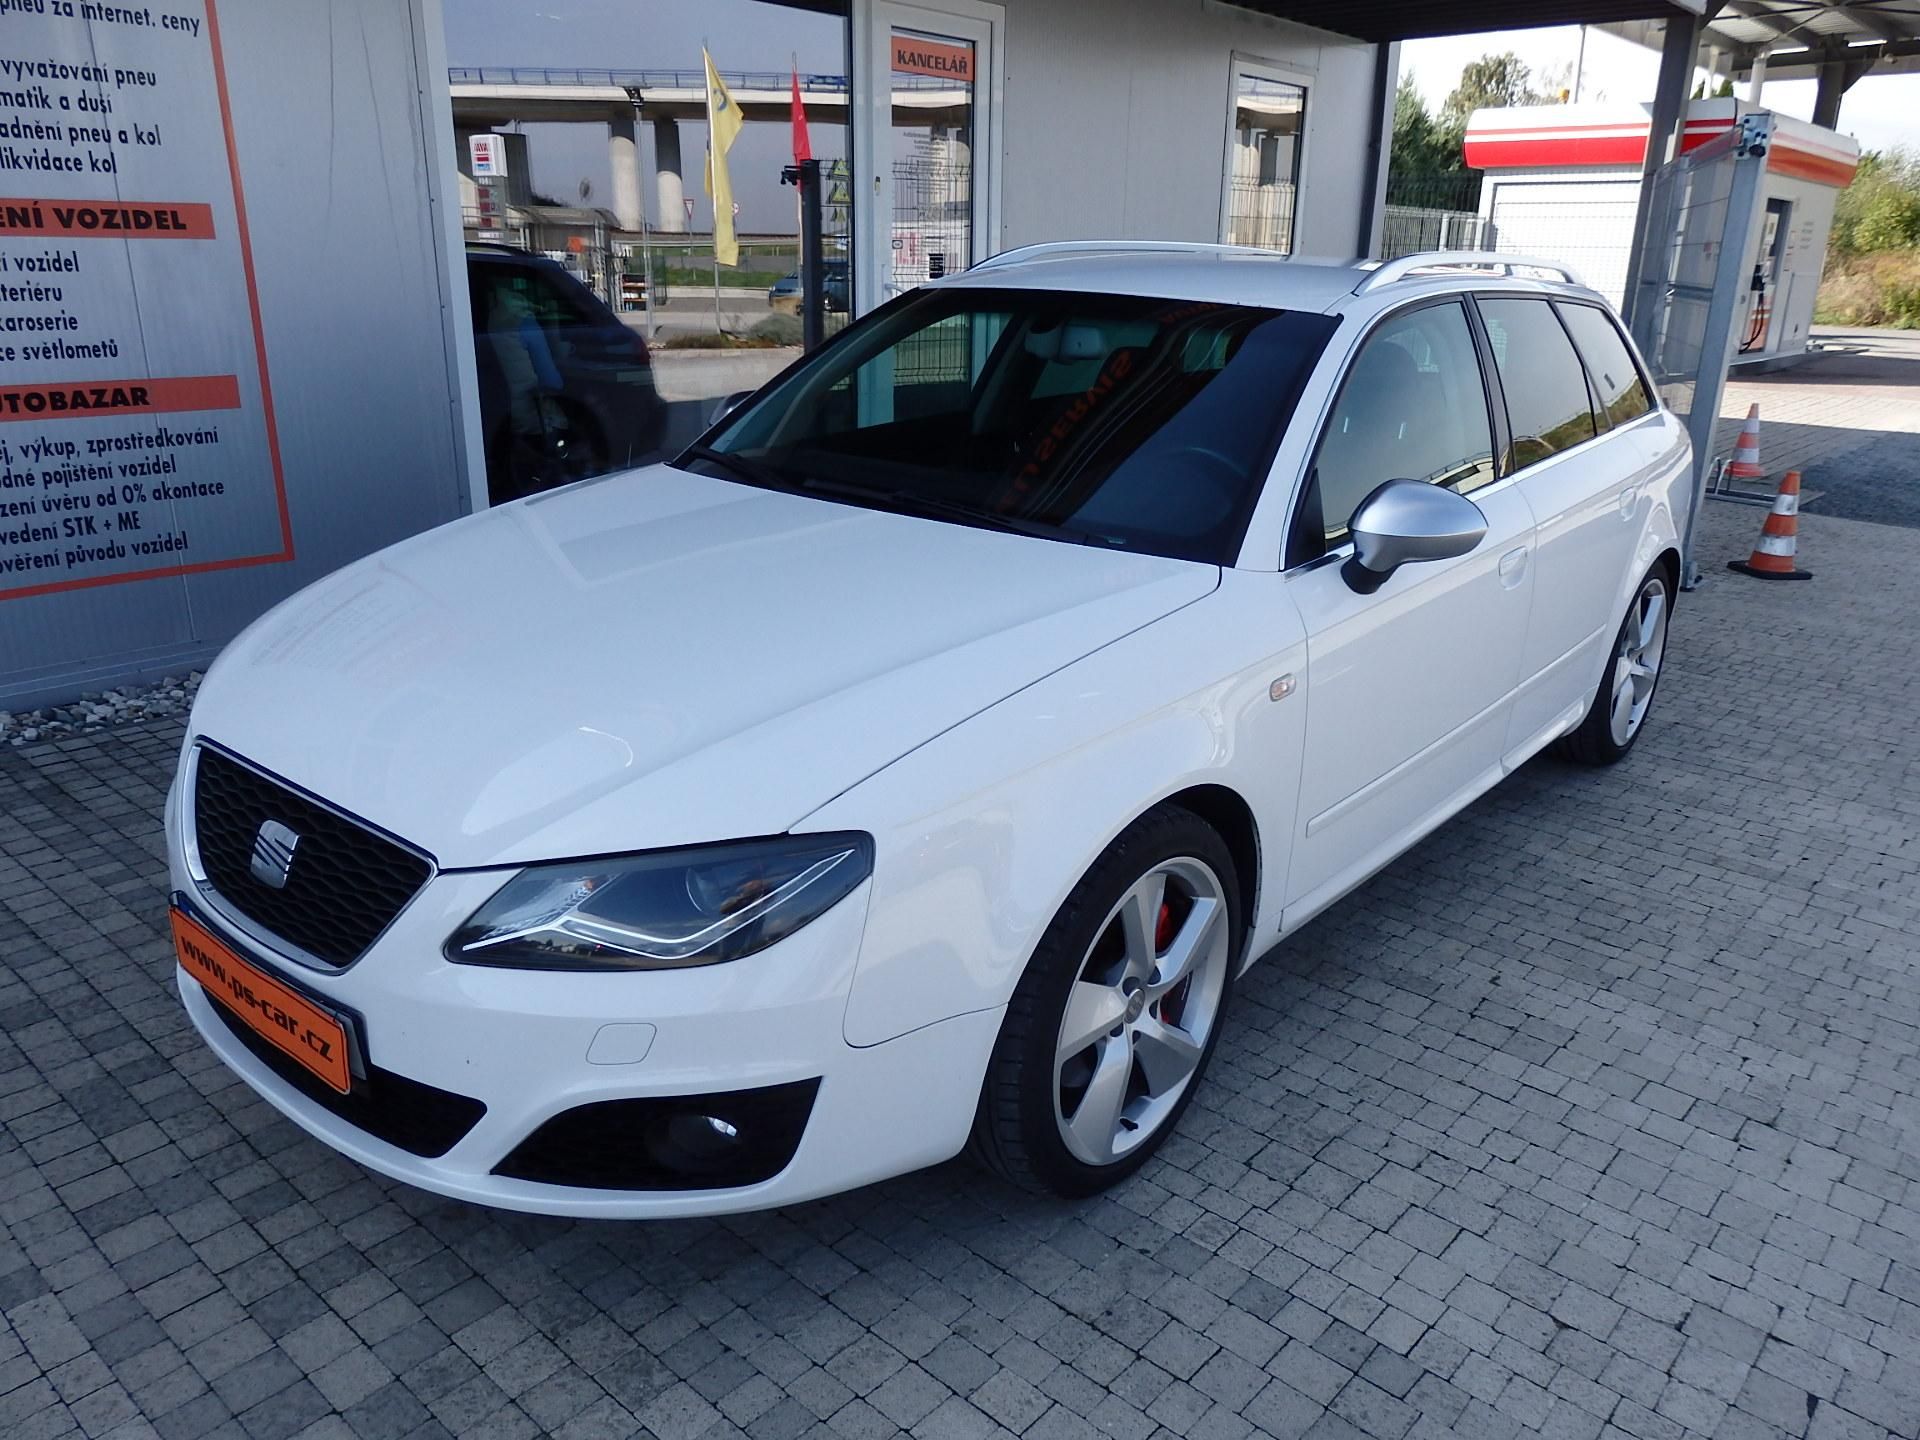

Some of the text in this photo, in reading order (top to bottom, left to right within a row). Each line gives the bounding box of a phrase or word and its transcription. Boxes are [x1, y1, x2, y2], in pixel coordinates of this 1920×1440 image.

[53, 0, 74, 18] za
[80, 0, 156, 27] internet.
[162, 14, 200, 37] ceny
[1, 58, 157, 89] vyvažování pneu
[897, 48, 968, 74] KANCELÁŘ
[59, 95, 70, 110] a
[78, 90, 112, 113] duší
[0, 116, 162, 146] adnění pneu a kol
[0, 147, 117, 174] likvidace kol
[53, 207, 187, 230] VOZIDEL
[14, 250, 80, 272] vozidel
[0, 280, 62, 302] teriéru
[22, 338, 118, 360] světlometů
[0, 386, 150, 413] TOBAZAR
[19, 436, 81, 463] výkup,
[86, 426, 219, 457] zprostředkování
[0, 454, 177, 490] dné pojištění vozidel
[42, 494, 91, 513] úvěru
[96, 486, 117, 508] od
[122, 483, 146, 504] 0%
[152, 481, 225, 501] akontace
[63, 516, 97, 538] STK
[103, 520, 112, 532] +
[118, 511, 141, 532] ME
[65, 540, 126, 569] původu
[131, 531, 188, 555] vozidel
[181, 936, 334, 1063] www.ps-car.cz
